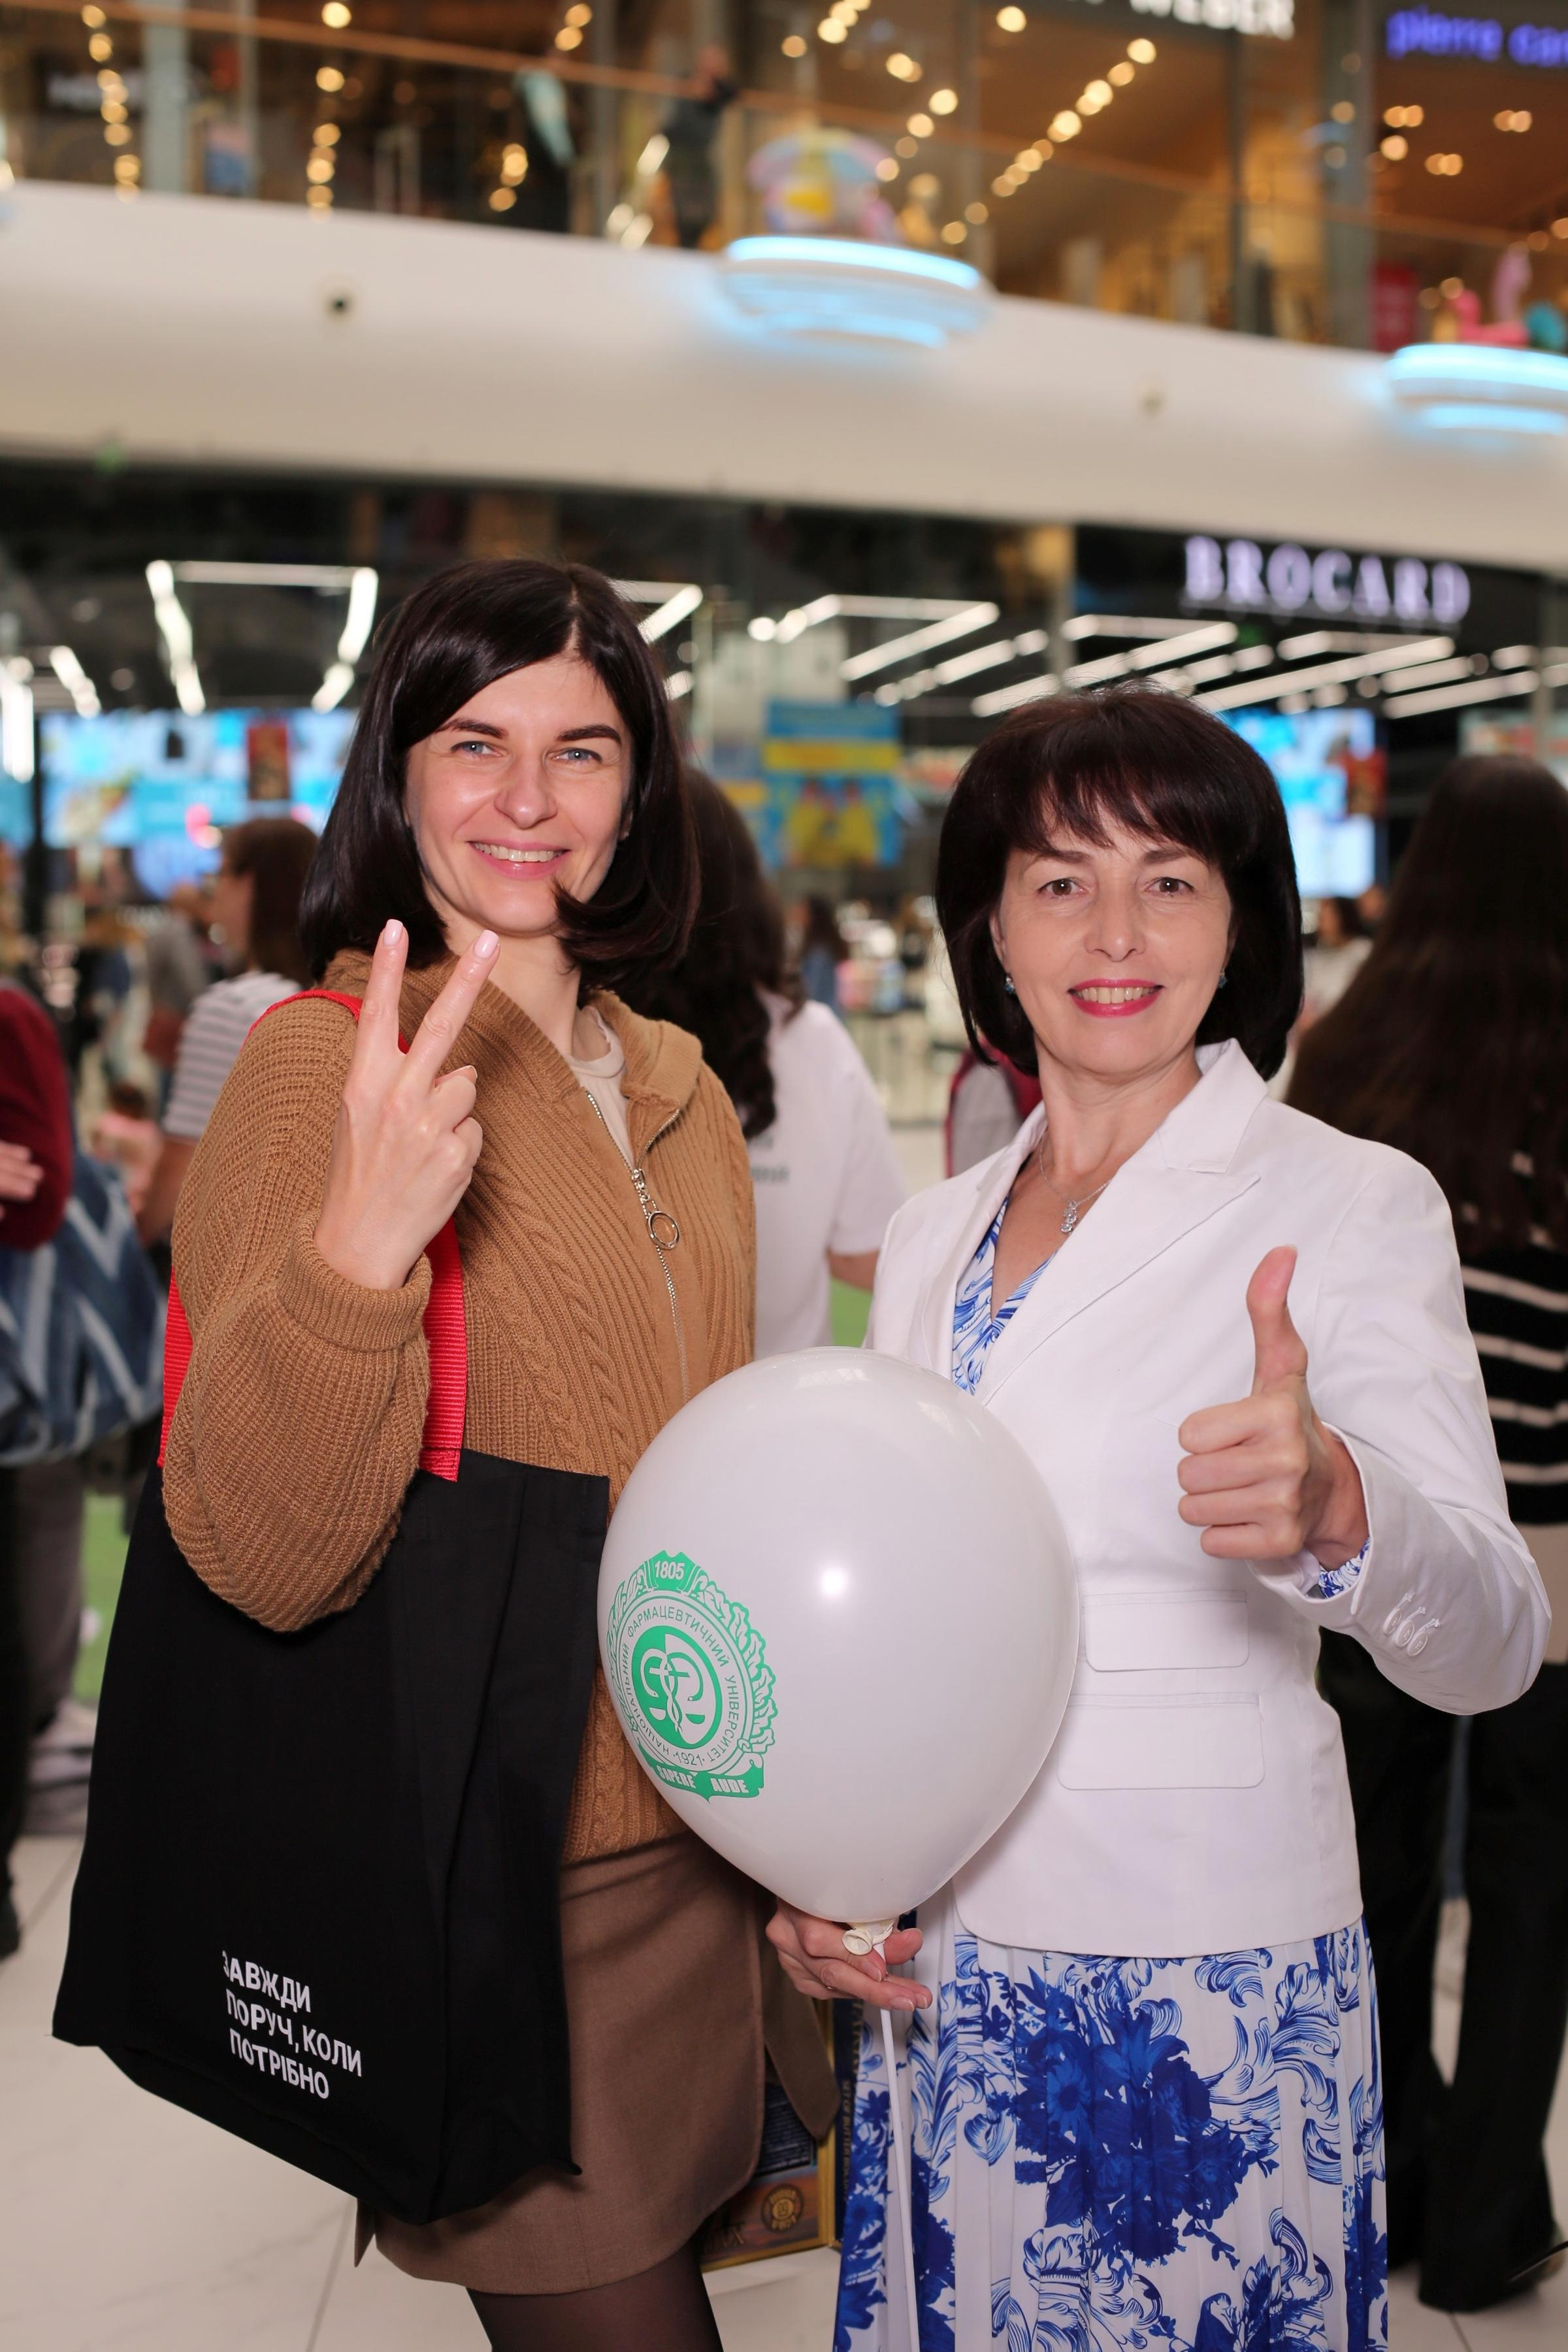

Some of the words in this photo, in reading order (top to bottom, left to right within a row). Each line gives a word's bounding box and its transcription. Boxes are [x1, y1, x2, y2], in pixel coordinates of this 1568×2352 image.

[1186, 536, 1471, 623] BROCARD
[655, 1560, 685, 1580] 1805
[627, 1605, 729, 1667] ФАРМАЦЕВТИЧНИЙ
[622, 1642, 670, 1755] НАЦІОНАЛЬНИЙ
[706, 1674, 739, 1762] УНІВЕРСИТЕТ
[656, 1765, 696, 1789] SAPERE
[710, 1778, 749, 1793] AUDE
[222, 1950, 311, 2012] ЗАВЖДИ
[230, 2028, 329, 2099] ПОТРІБНО
[302, 2025, 362, 2077] КОЛИ
